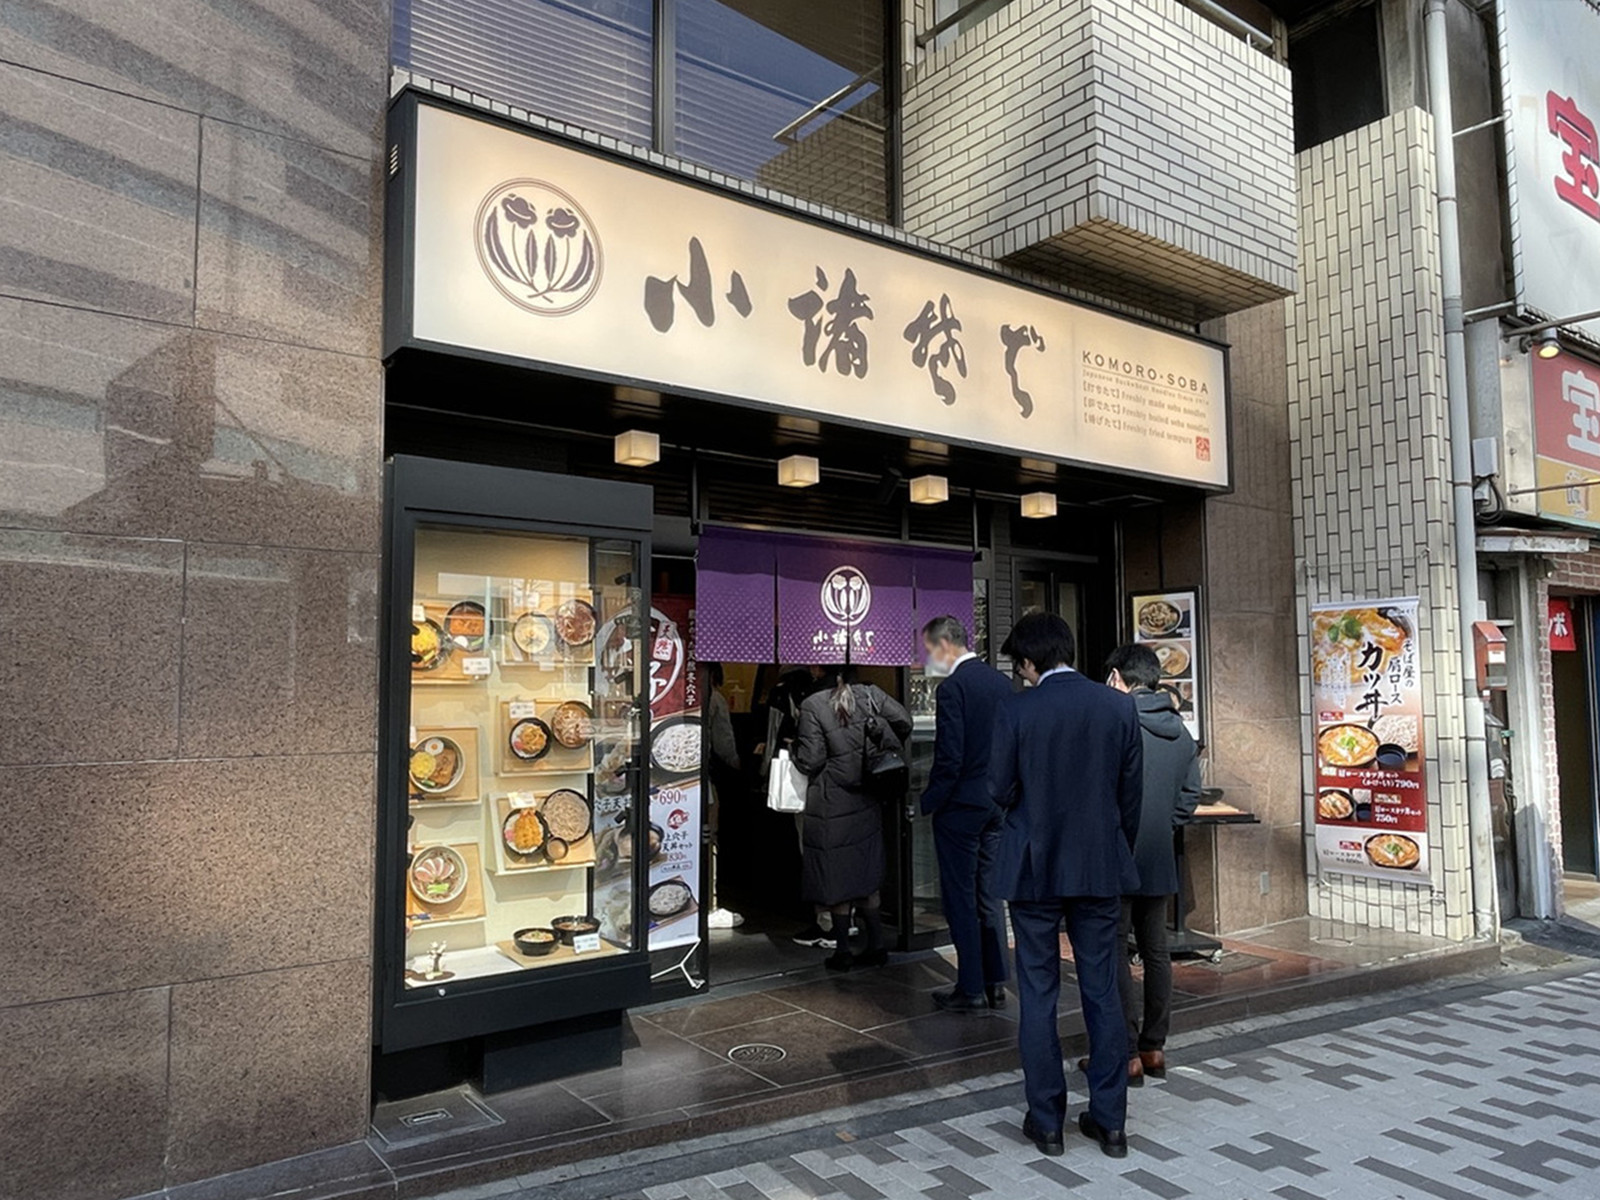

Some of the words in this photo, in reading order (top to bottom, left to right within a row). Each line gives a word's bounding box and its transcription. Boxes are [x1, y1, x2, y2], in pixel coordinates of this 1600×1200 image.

[1546, 89, 1600, 224] 宝
[1562, 370, 1600, 456] 宝
[1355, 640, 1389, 729] カツ丼
[1388, 656, 1403, 704] 肩ロース
